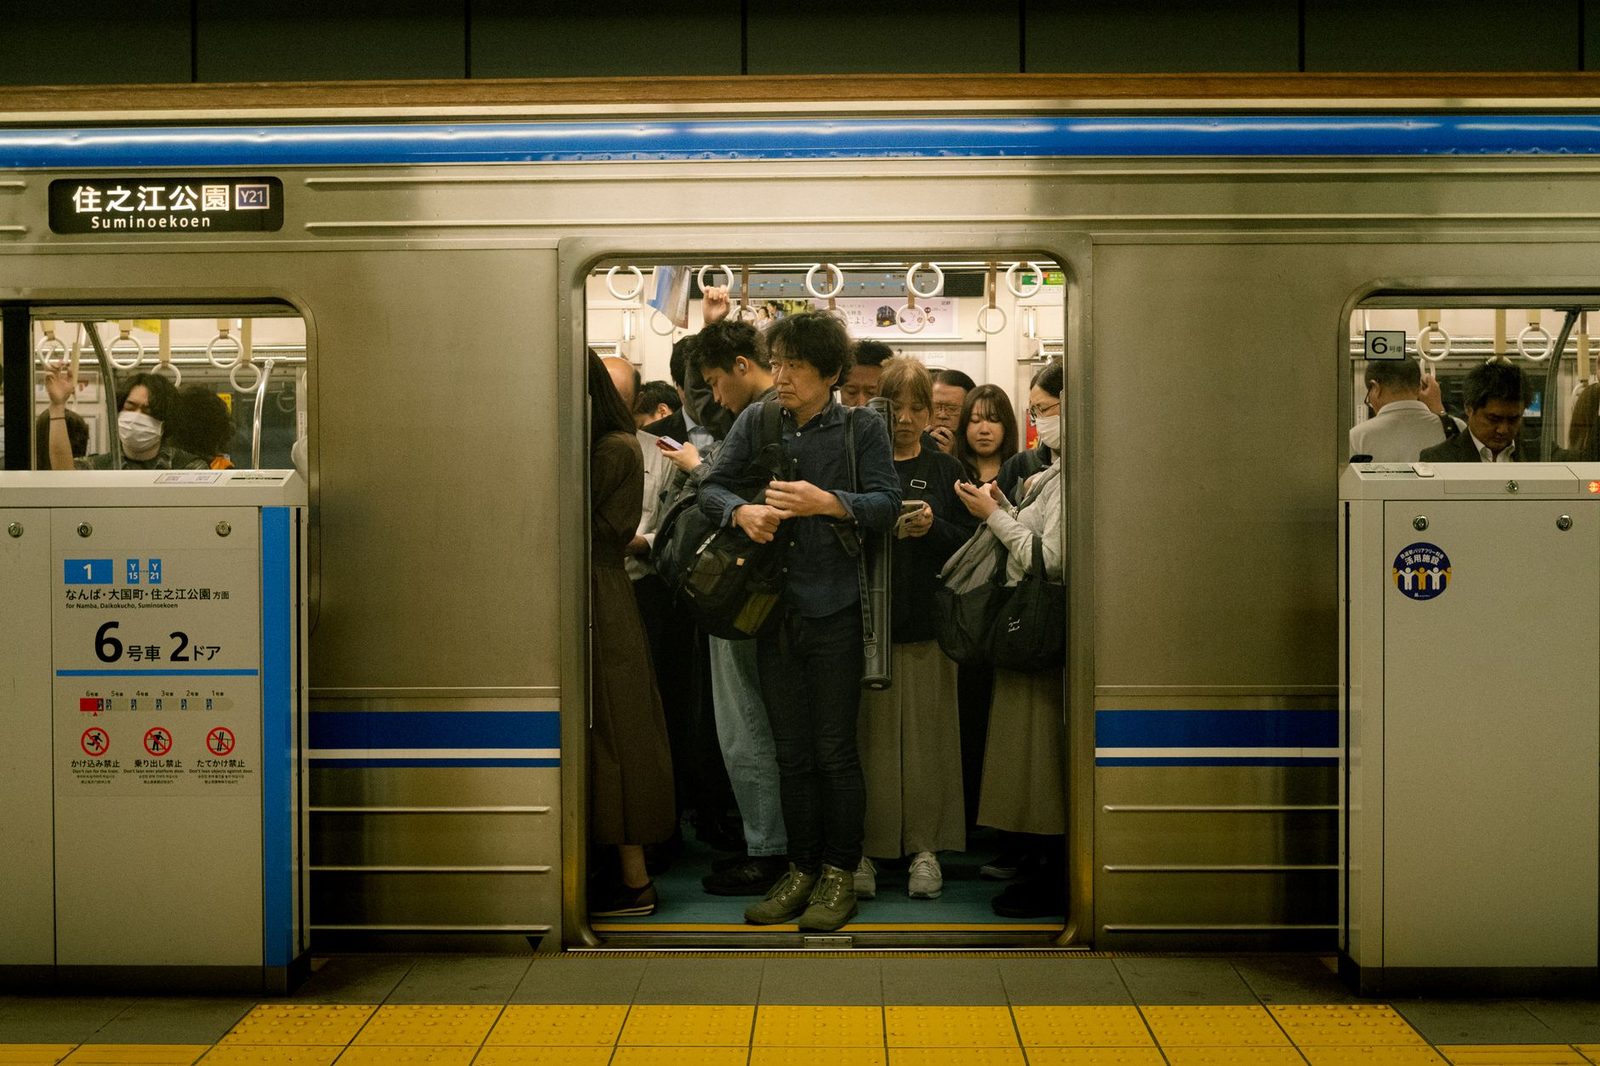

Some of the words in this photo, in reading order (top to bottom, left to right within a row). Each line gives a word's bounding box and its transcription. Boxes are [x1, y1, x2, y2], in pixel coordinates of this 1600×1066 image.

[72, 185, 229, 213] 住之江公園
[240, 190, 264, 204] Y21
[91, 215, 211, 229] Suminoekoen
[1404, 554, 1441, 566] 活用施設
[83, 563, 92, 580] 1
[129, 563, 136, 571] Y
[151, 563, 158, 571] Y
[129, 572, 138, 580] 15
[150, 572, 159, 580] 21
[66, 588, 211, 601] なんば・大国町・住之江公園
[213, 591, 230, 600] 方面
[95, 621, 161, 663] 6号車
[169, 631, 221, 662] 2ドア
[71, 759, 120, 768] かけ込み禁止
[134, 759, 183, 768] 乗り出し禁止
[196, 759, 246, 768] たてかけ禁止
